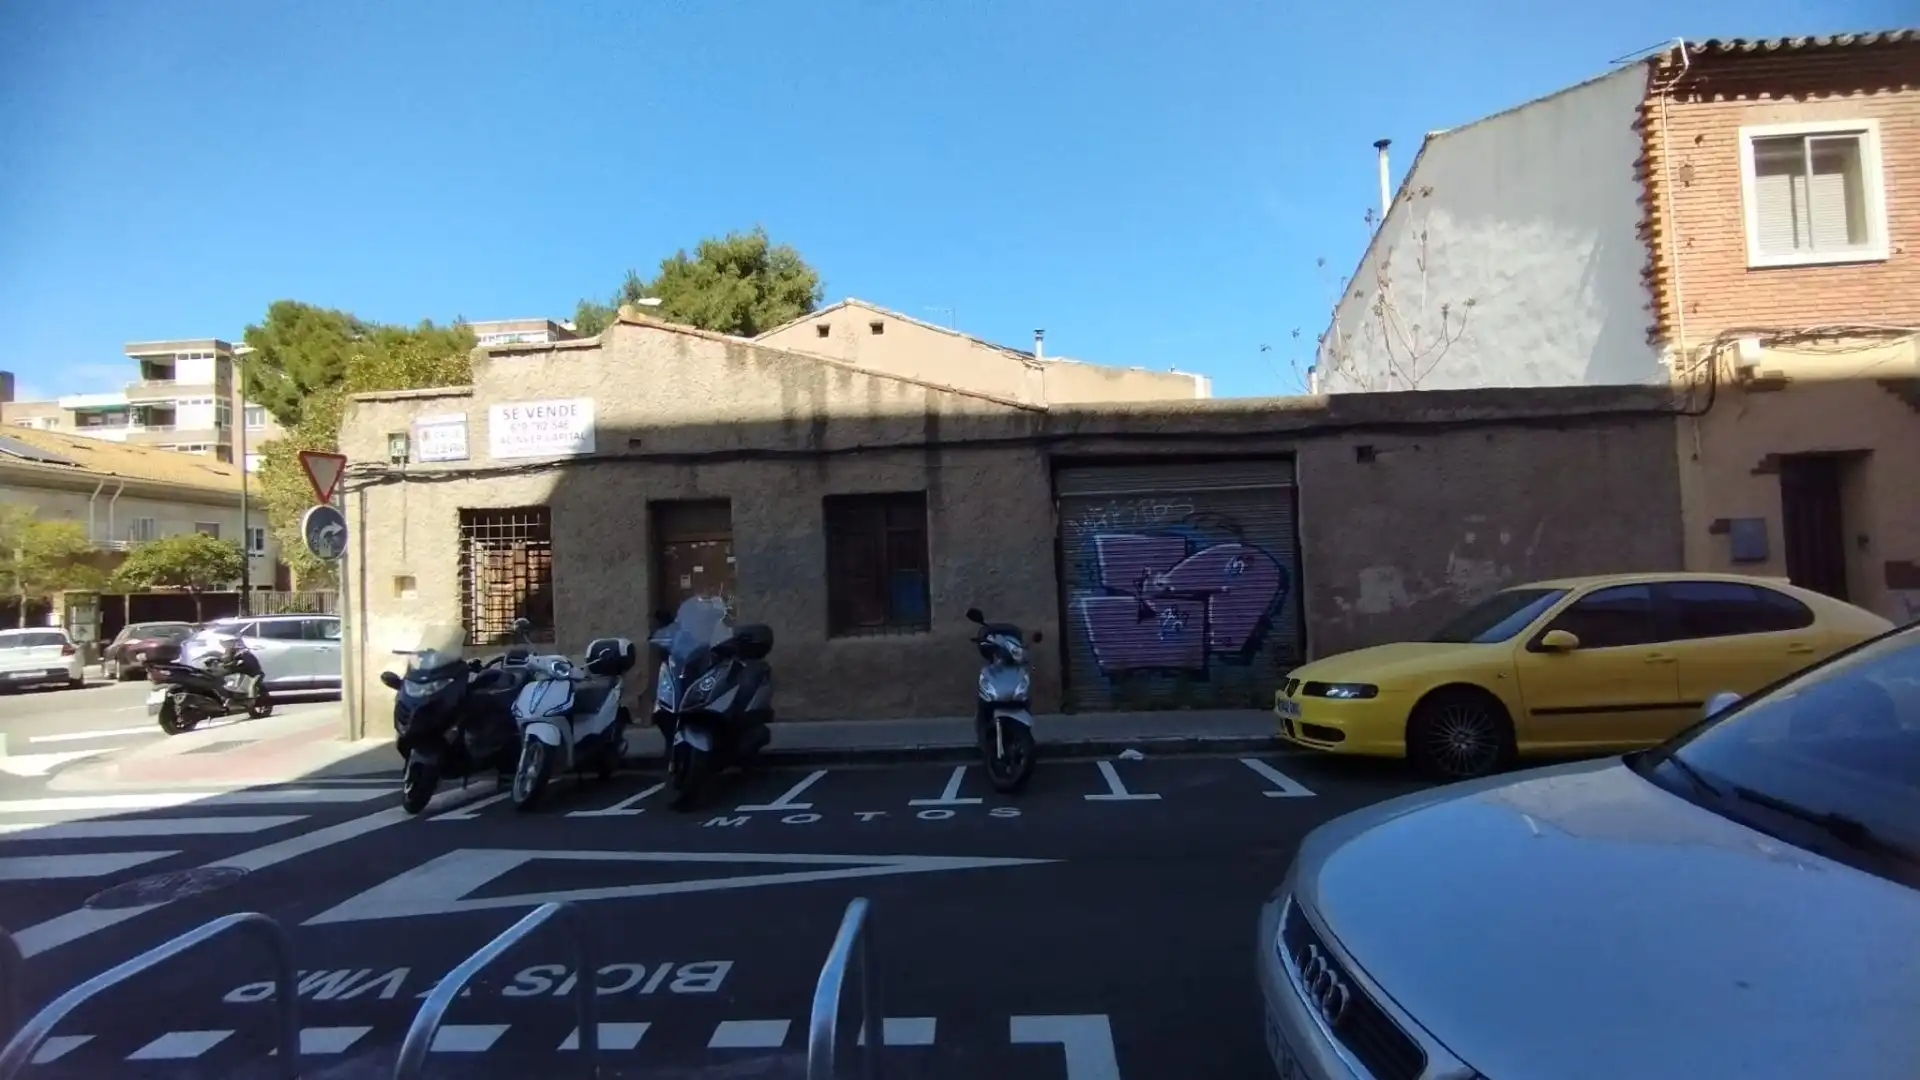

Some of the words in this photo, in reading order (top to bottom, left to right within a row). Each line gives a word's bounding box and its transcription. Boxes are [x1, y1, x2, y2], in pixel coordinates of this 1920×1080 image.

[503, 408, 520, 420] SE
[525, 404, 578, 419] VENDE
[702, 807, 1022, 828] MOTOS
[502, 961, 735, 998] BICIS
